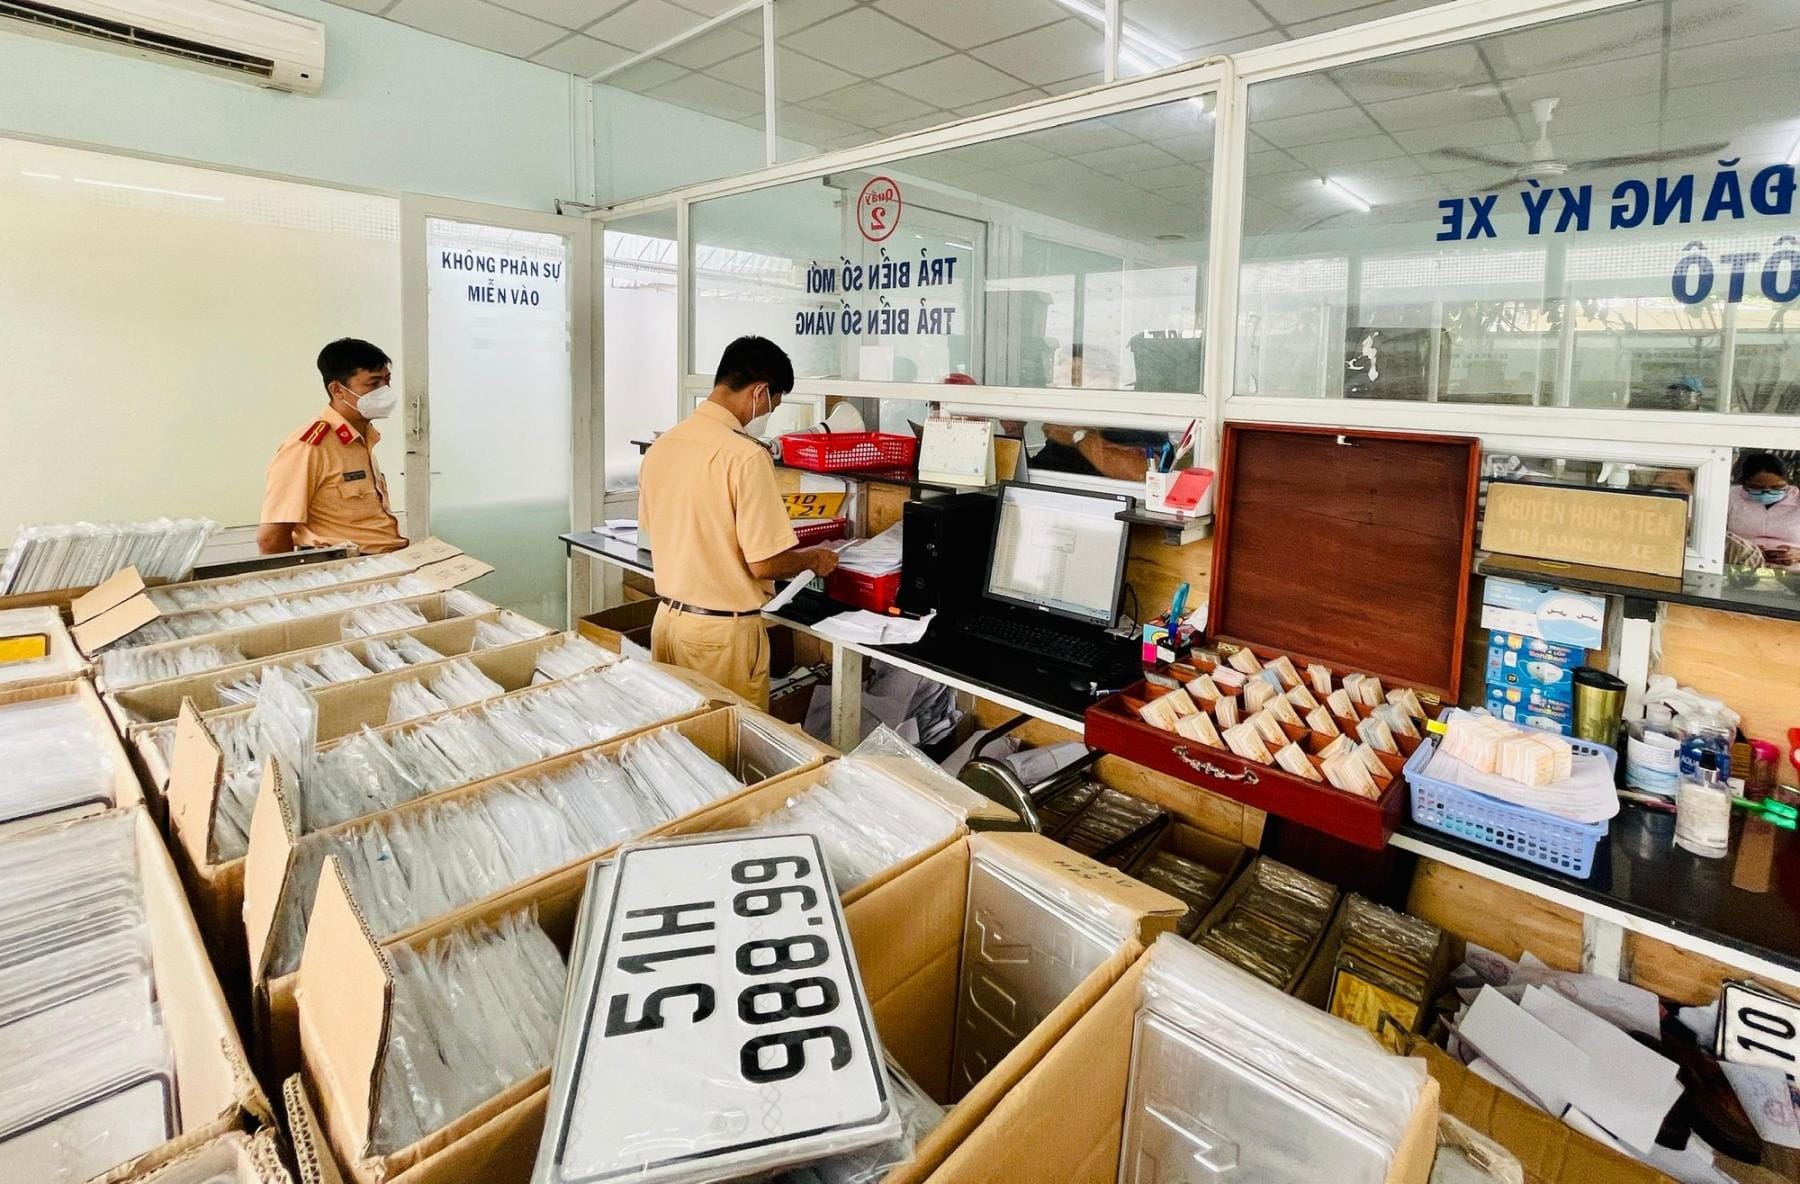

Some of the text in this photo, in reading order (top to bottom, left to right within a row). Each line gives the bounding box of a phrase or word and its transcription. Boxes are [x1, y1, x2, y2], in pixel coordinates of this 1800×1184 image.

[442, 249, 496, 273] KHÔNG
[543, 261, 562, 283] SỰ
[468, 278, 539, 306] MIỄN VÀO
[604, 900, 716, 1038] 51H
[730, 855, 852, 1084] 988.99
